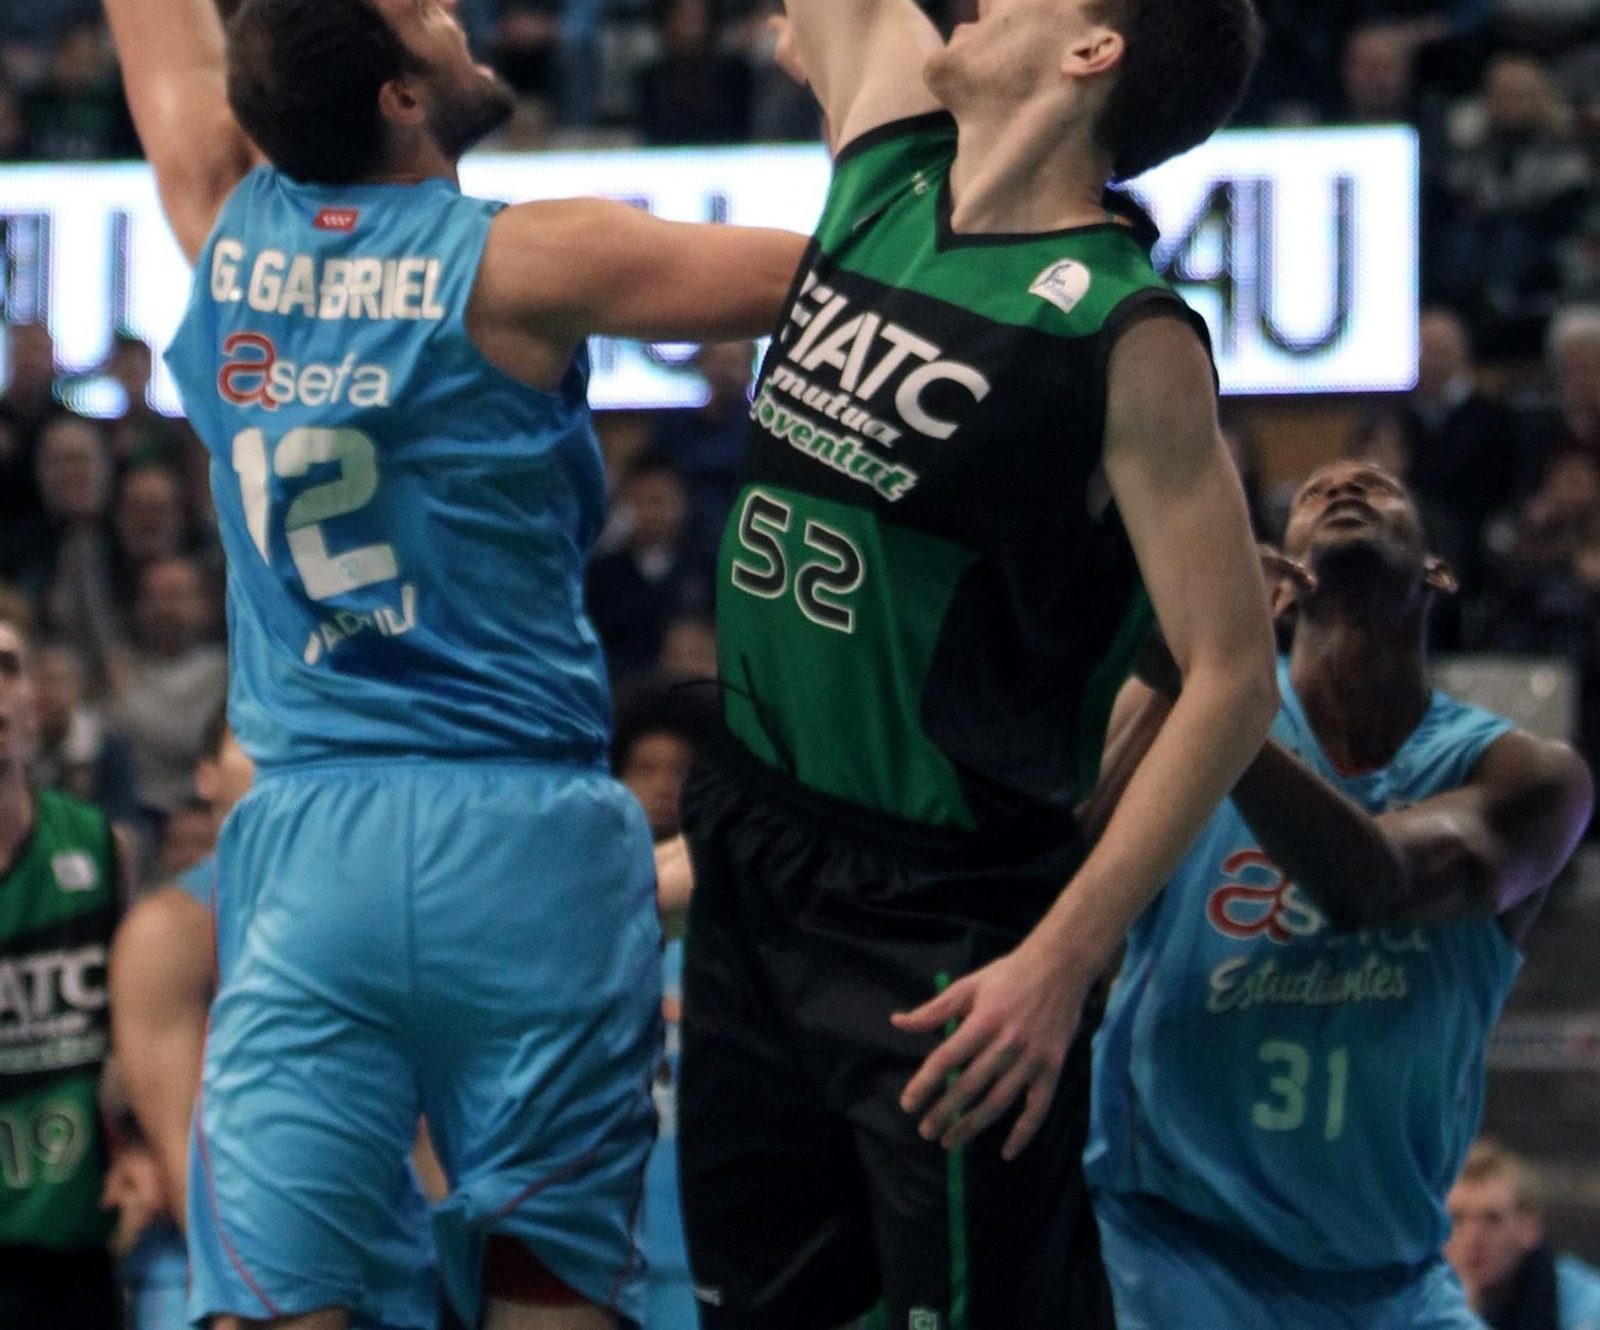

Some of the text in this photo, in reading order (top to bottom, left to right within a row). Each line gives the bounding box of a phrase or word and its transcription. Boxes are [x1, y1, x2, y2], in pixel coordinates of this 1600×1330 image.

[248, 249, 445, 321] GABRIEL
[771, 365, 902, 449] mutua
[231, 426, 399, 602] 12
[731, 488, 866, 634] 52
[1251, 1039, 1349, 1142] 31
